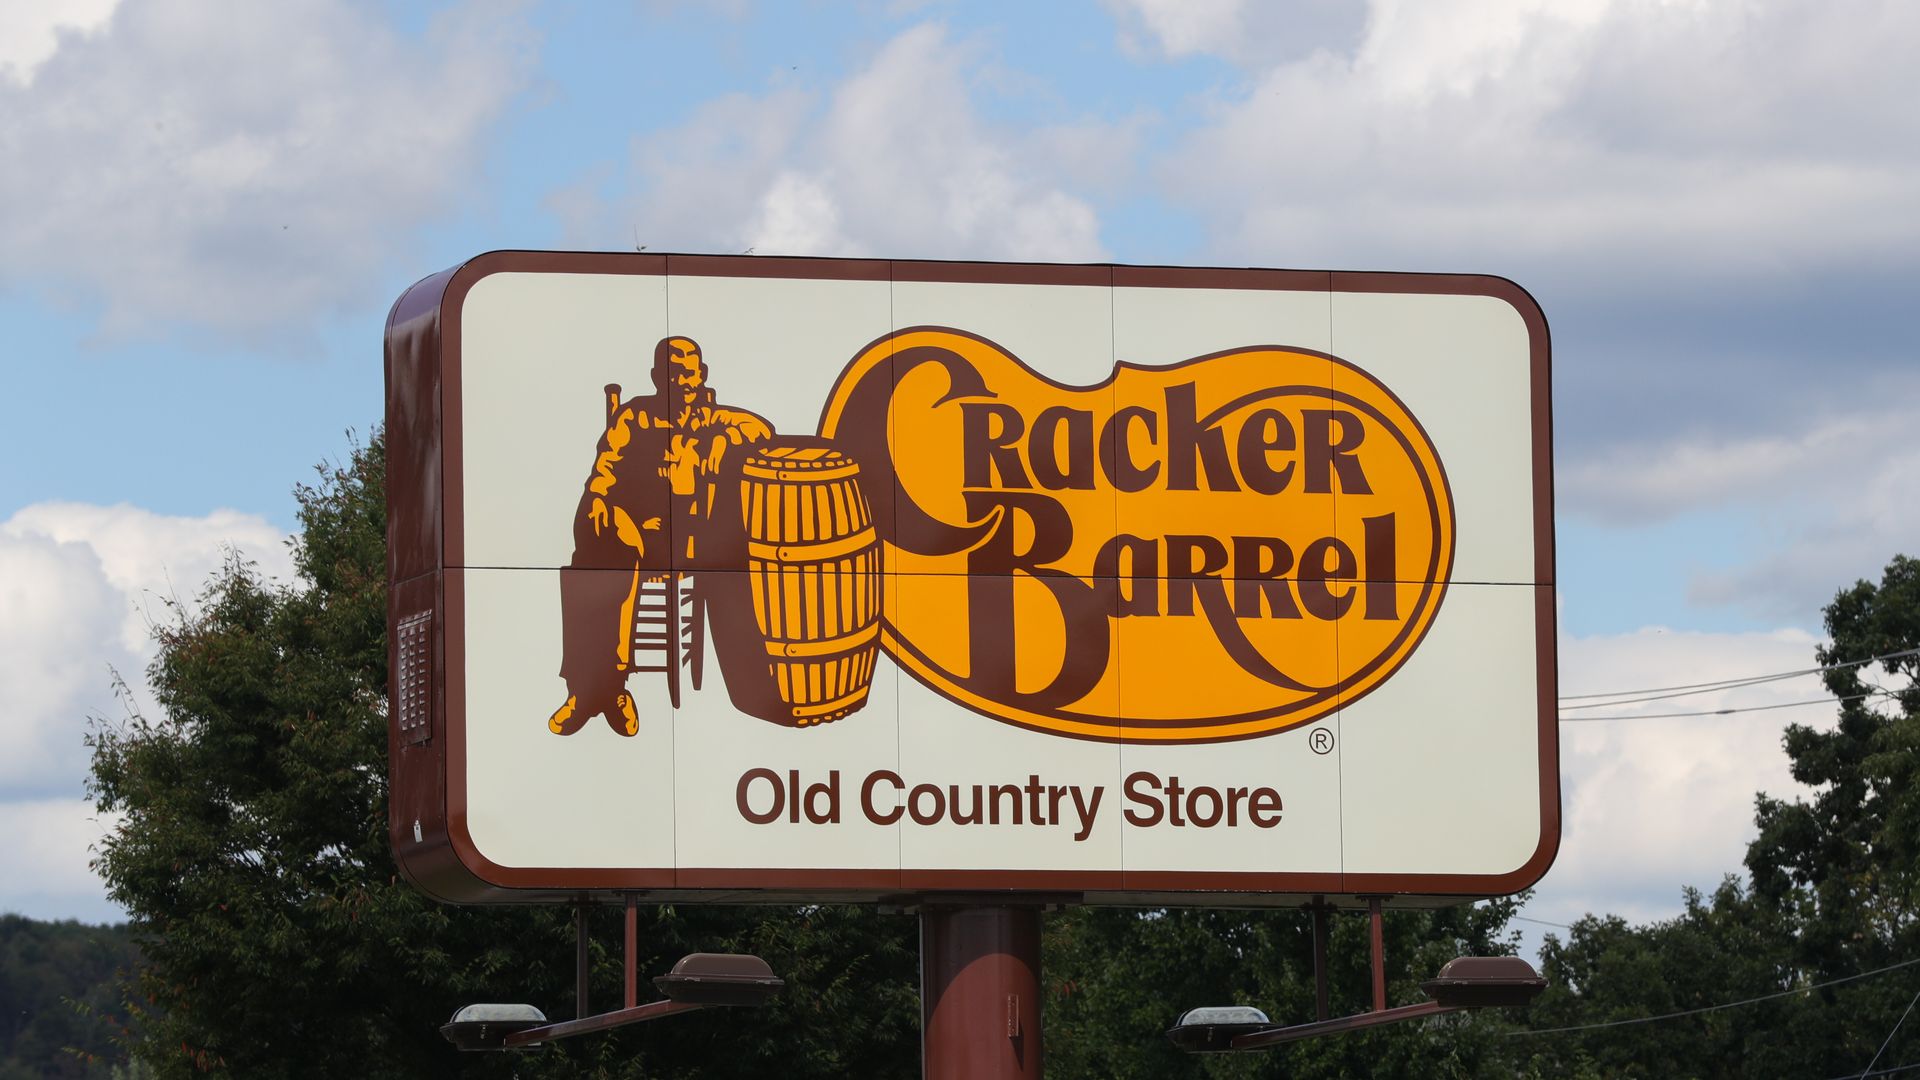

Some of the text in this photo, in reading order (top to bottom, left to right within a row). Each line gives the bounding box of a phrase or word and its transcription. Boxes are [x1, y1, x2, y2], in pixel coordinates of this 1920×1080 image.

[736, 768, 1283, 841] Old Country Store
